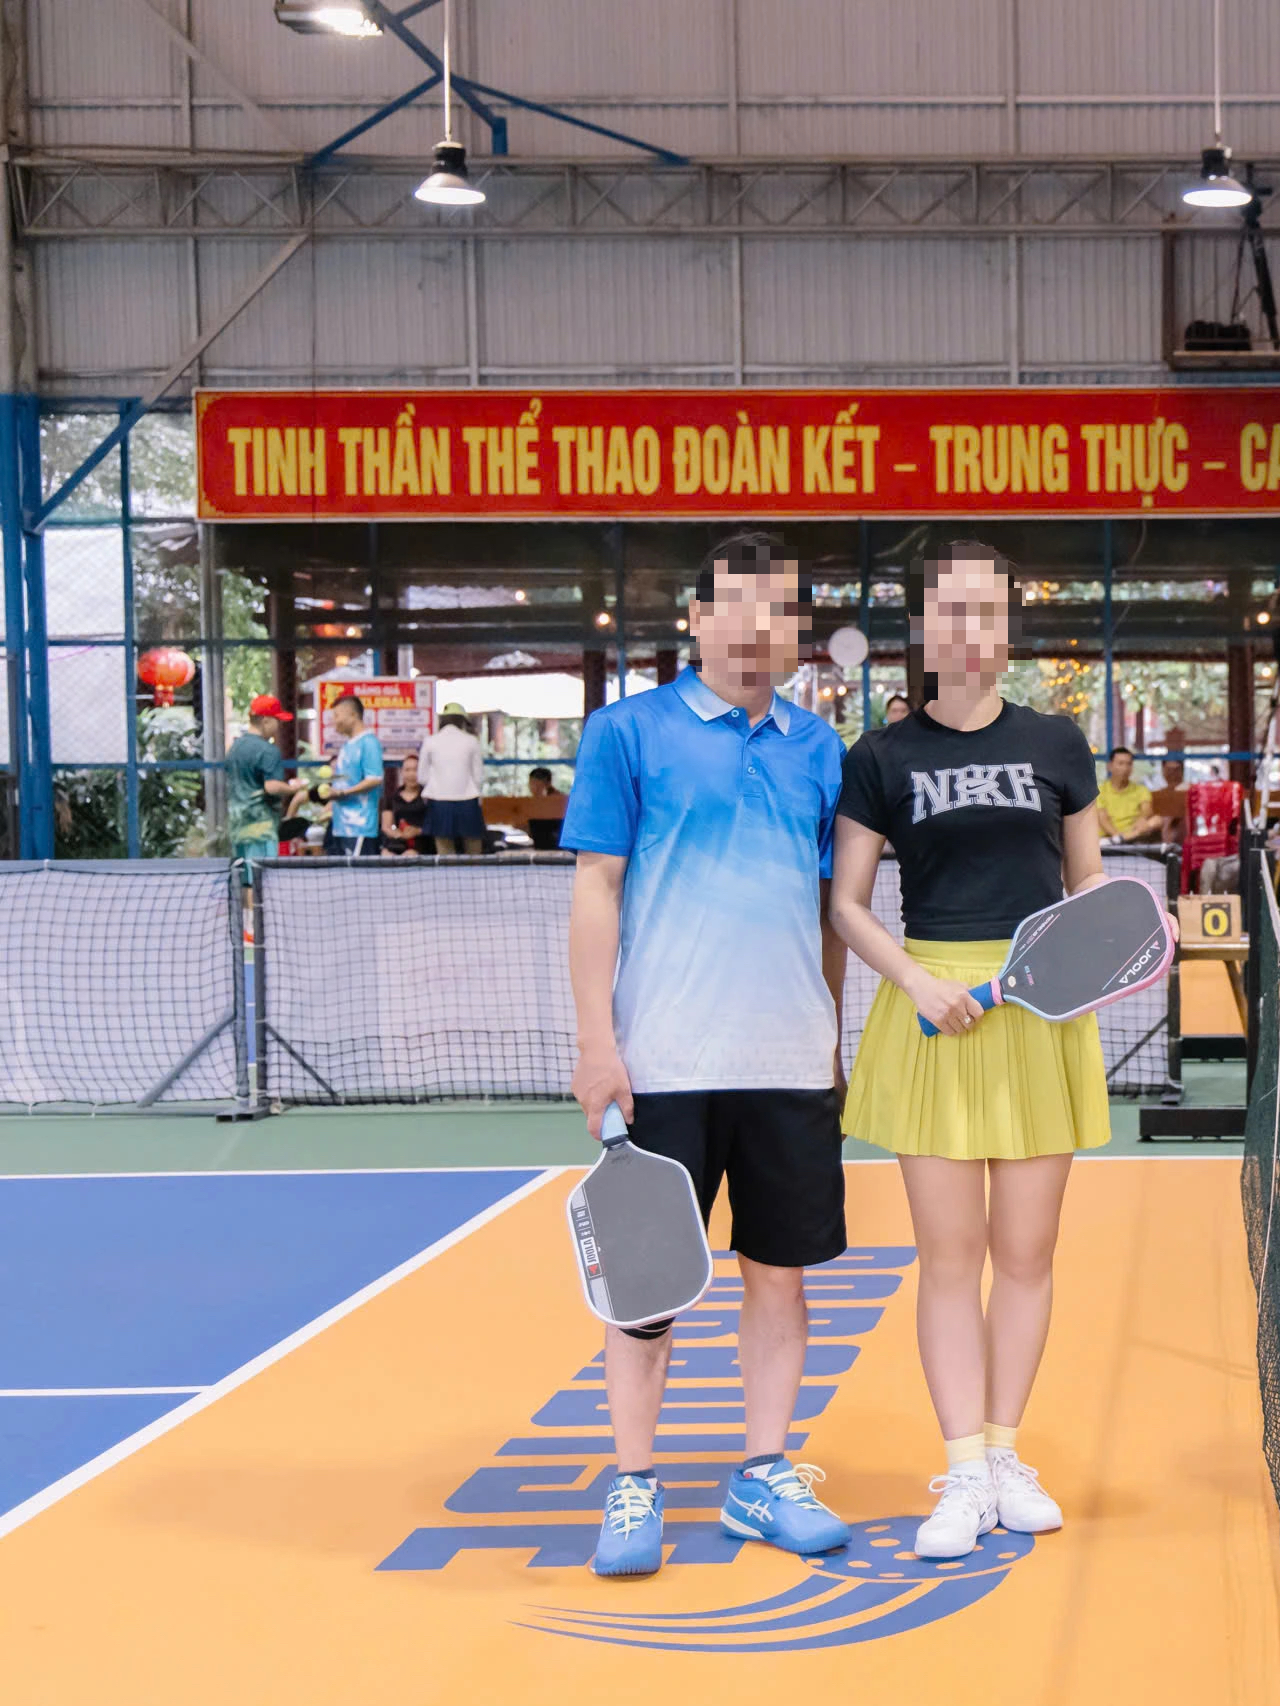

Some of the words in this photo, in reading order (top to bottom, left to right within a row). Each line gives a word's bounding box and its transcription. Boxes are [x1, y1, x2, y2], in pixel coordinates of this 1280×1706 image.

[228, 427, 327, 496] TINH
[338, 403, 451, 496] THẦN
[462, 398, 542, 495] THỂ
[552, 425, 661, 496] THAO
[672, 411, 790, 495] ĐOÀN
[803, 403, 880, 494] KẾT
[929, 425, 1069, 494] TRUNG
[1080, 416, 1188, 508] THỰC
[911, 763, 1041, 824] NIKE
[1204, 908, 1228, 936] 0
[1118, 948, 1152, 984] JOOLA
[583, 1238, 597, 1263] JOOLA
